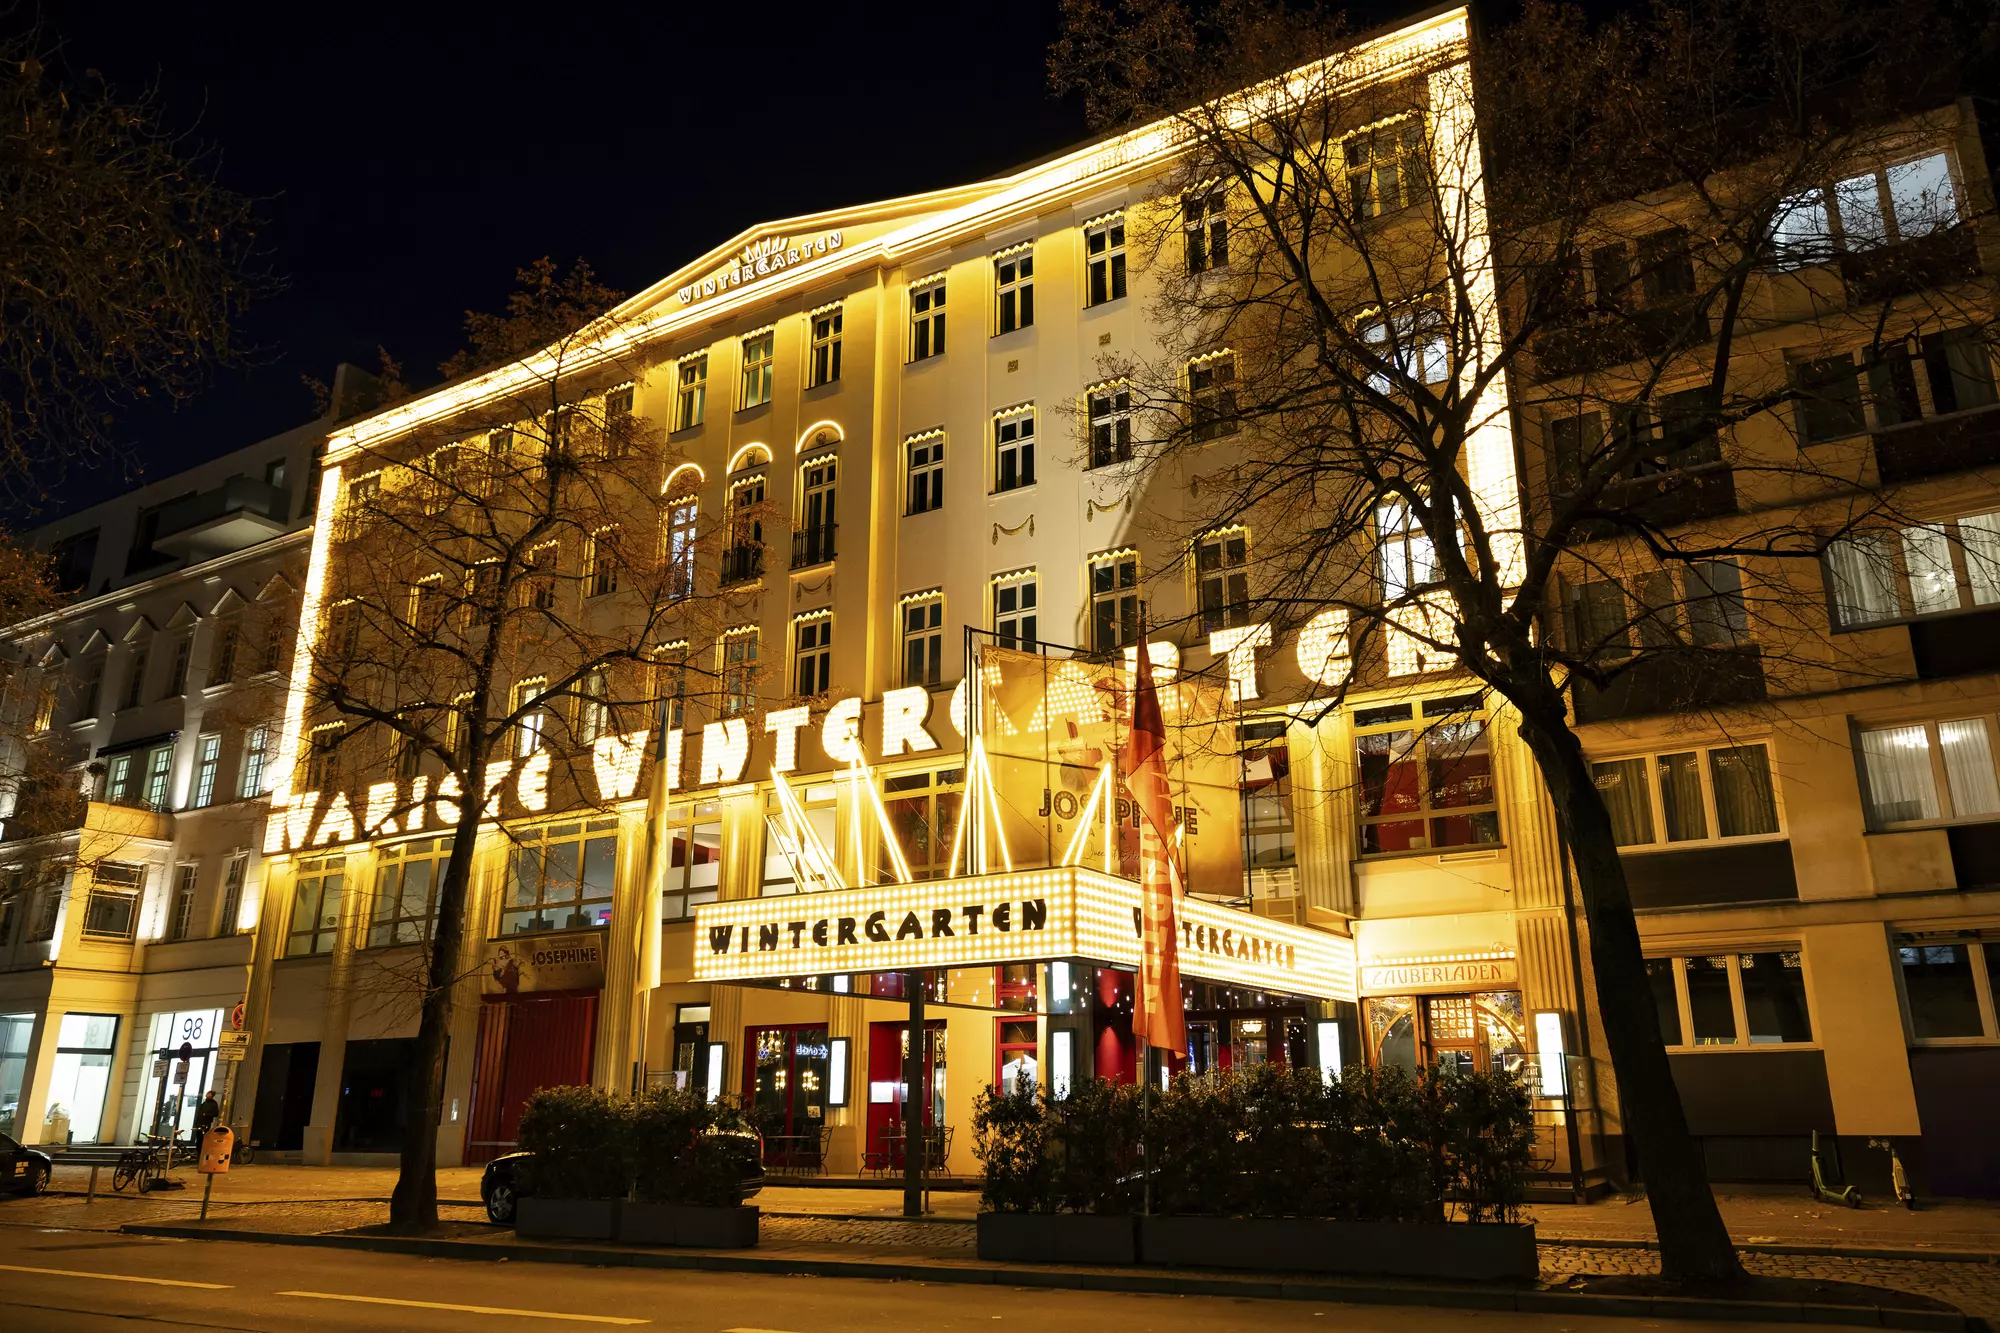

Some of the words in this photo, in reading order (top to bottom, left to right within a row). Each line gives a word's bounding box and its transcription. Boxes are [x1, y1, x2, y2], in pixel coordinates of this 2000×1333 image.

[677, 230, 844, 305] WINTERGARTEN
[708, 898, 1047, 956] WINTERGARTEN
[1133, 906, 1295, 969] TERGARTEN
[530, 947, 597, 967] JOSEPHINE
[1372, 963, 1502, 986] ZAUBERLADEN
[182, 1017, 204, 1041] 98
